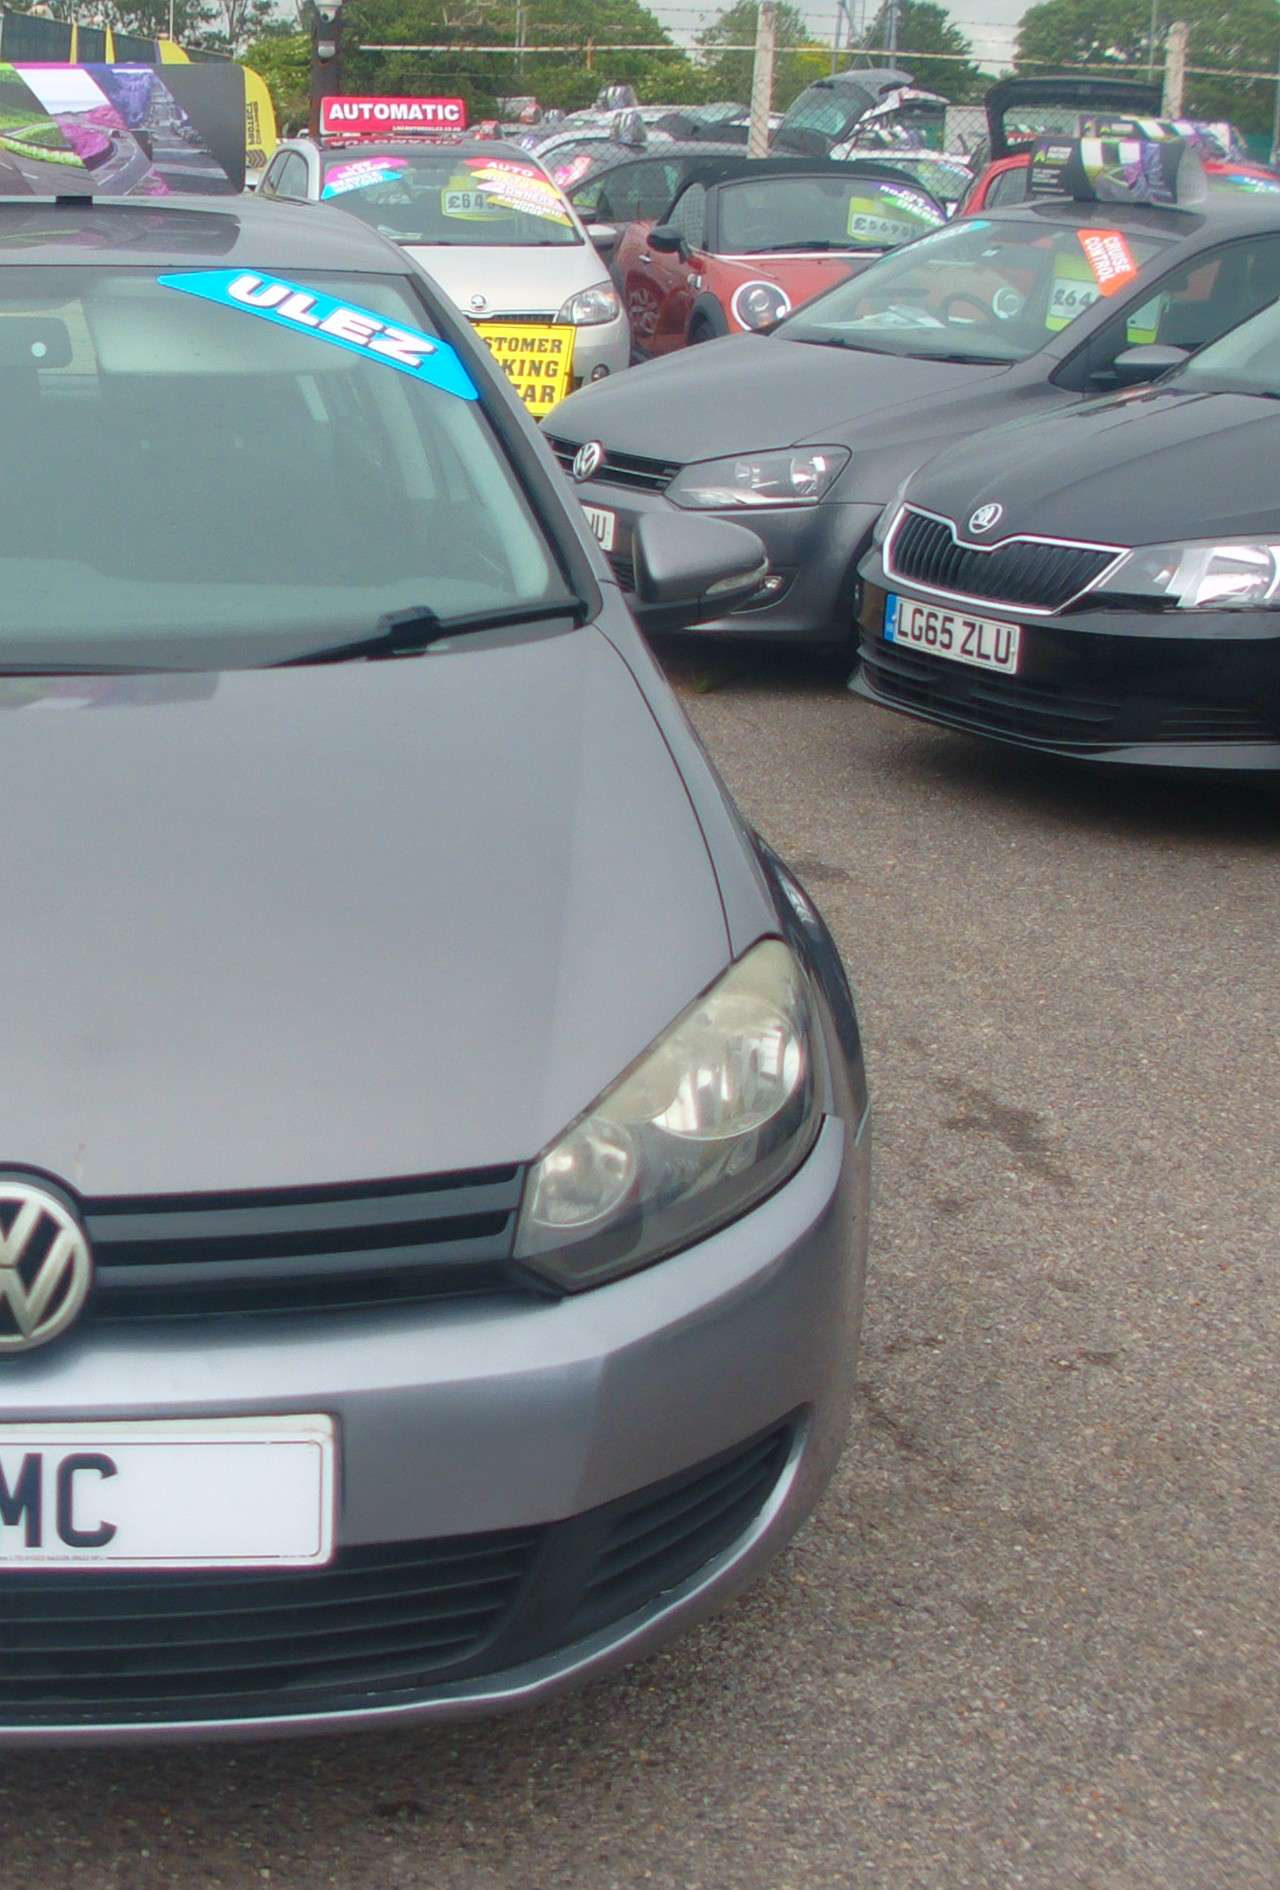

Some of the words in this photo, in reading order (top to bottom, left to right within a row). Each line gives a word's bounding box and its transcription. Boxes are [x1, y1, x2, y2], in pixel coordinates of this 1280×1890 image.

[329, 103, 460, 121] AUTOMATIC
[486, 161, 535, 177] AUTO
[1085, 236, 1115, 283] CONTROL
[1103, 236, 1131, 273] CRUISE
[228, 274, 437, 368] ULEZ
[496, 358, 560, 378] KING
[897, 602, 955, 651] LG65
[959, 620, 1012, 665] ZLU
